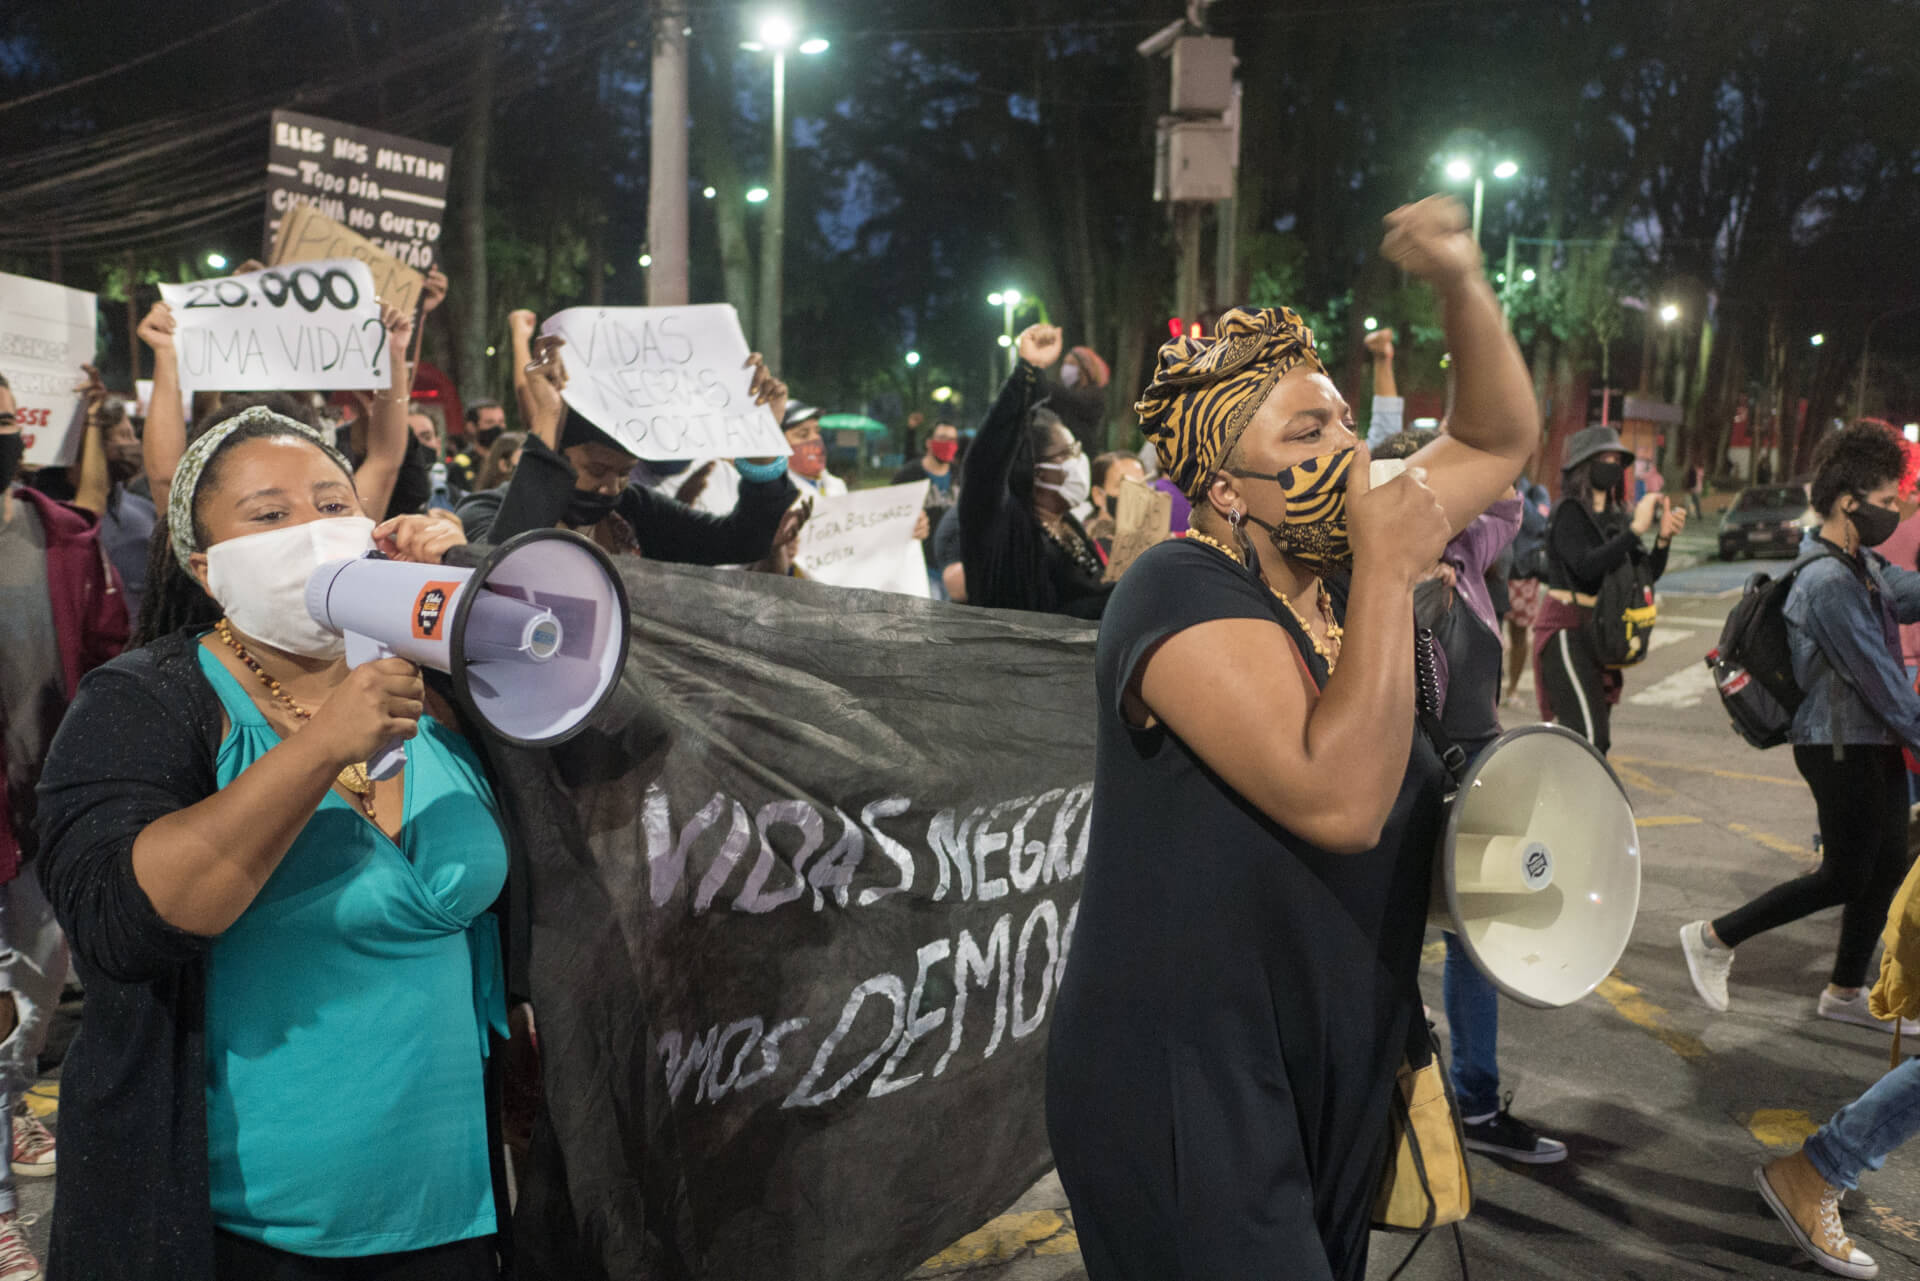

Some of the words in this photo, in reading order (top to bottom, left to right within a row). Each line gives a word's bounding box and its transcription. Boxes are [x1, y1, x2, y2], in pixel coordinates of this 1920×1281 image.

[275, 121, 326, 153] ELES
[332, 135, 369, 164] NOS
[376, 147, 446, 182] MATAM
[349, 207, 375, 230] NO
[379, 209, 441, 240] GUETO
[183, 267, 359, 312] 20.000
[182, 325, 269, 377] UMA
[276, 318, 387, 377] VIDA?
[559, 312, 694, 368] VIDAS
[590, 367, 731, 412] NEGRAS
[642, 780, 915, 916] VIDAS
